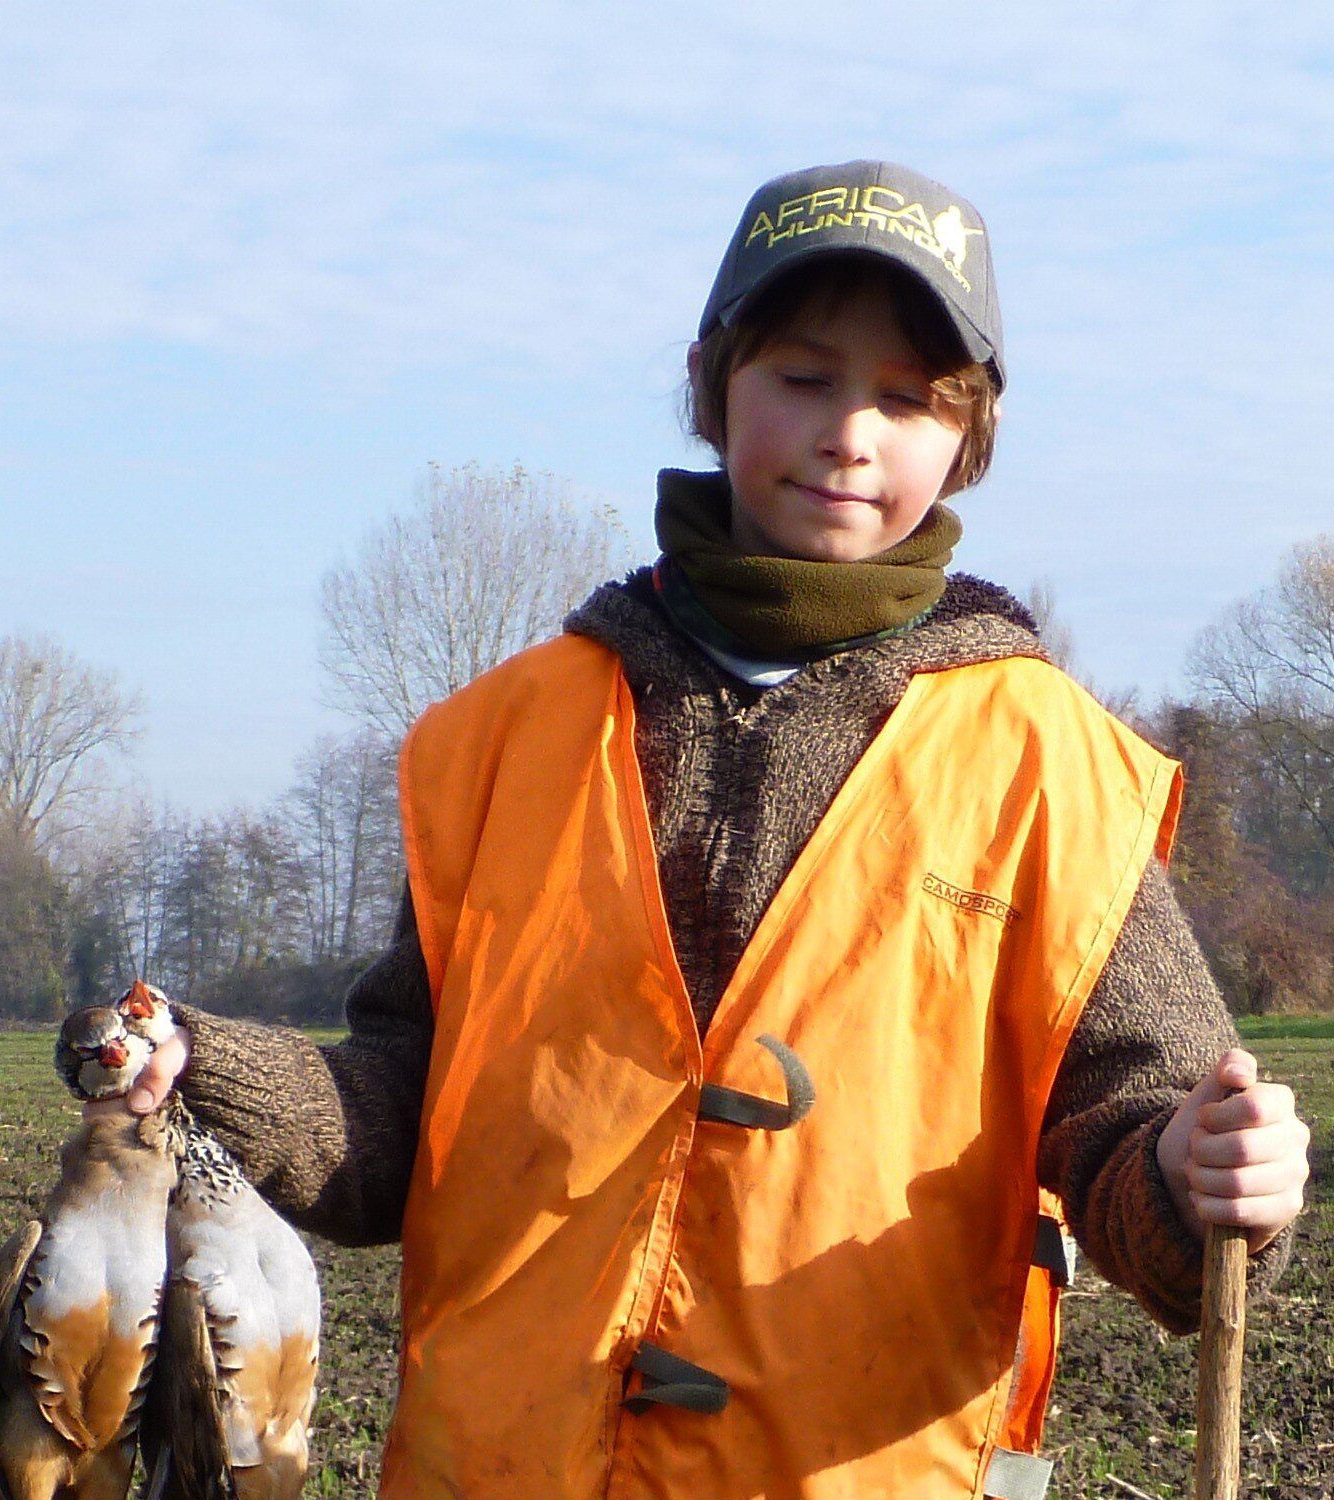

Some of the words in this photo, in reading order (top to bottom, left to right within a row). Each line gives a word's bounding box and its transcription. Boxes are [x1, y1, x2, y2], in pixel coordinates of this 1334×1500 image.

[745, 186, 935, 248] AFRICA
[768, 211, 945, 258] HUNTING
[922, 876, 1023, 920] CAMOSPO
